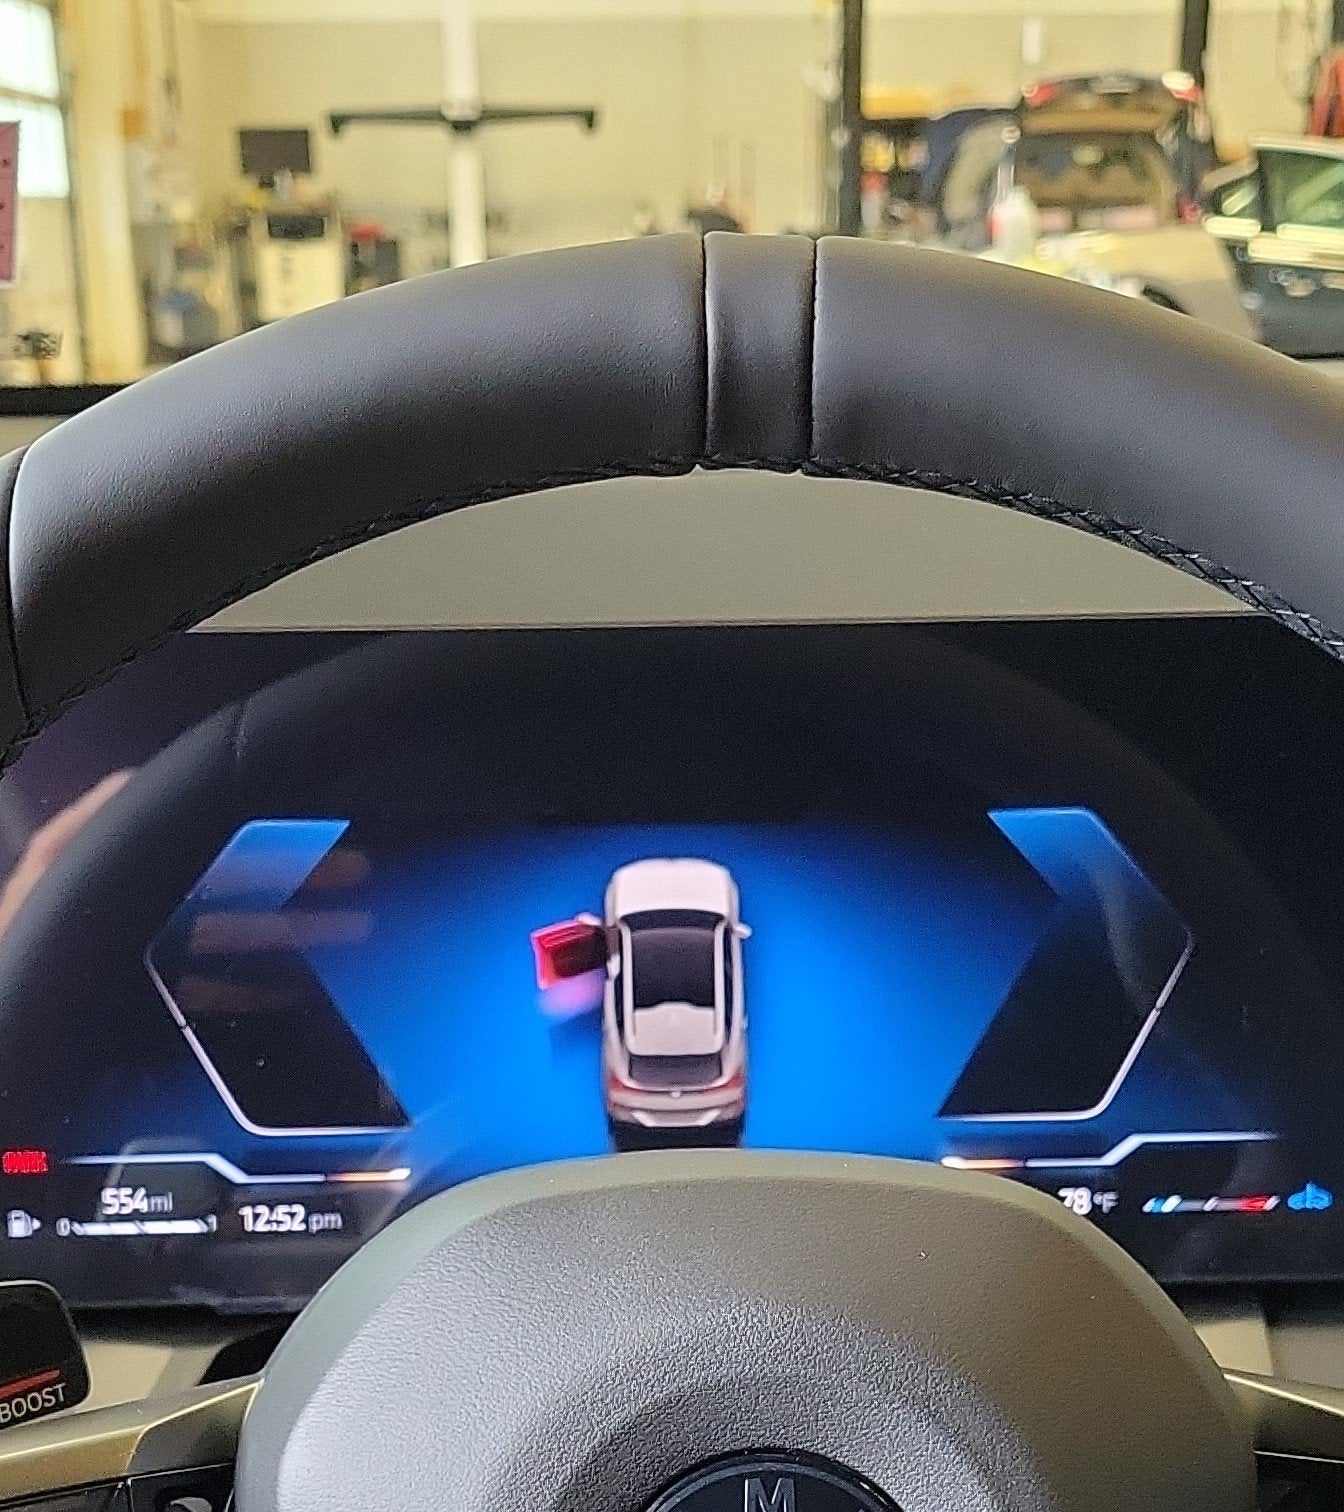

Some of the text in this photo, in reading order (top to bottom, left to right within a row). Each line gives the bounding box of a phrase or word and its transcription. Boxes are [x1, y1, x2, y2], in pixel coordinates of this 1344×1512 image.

[1058, 1187, 1092, 1215] 78
[239, 1204, 343, 1233] 12:52 pm
